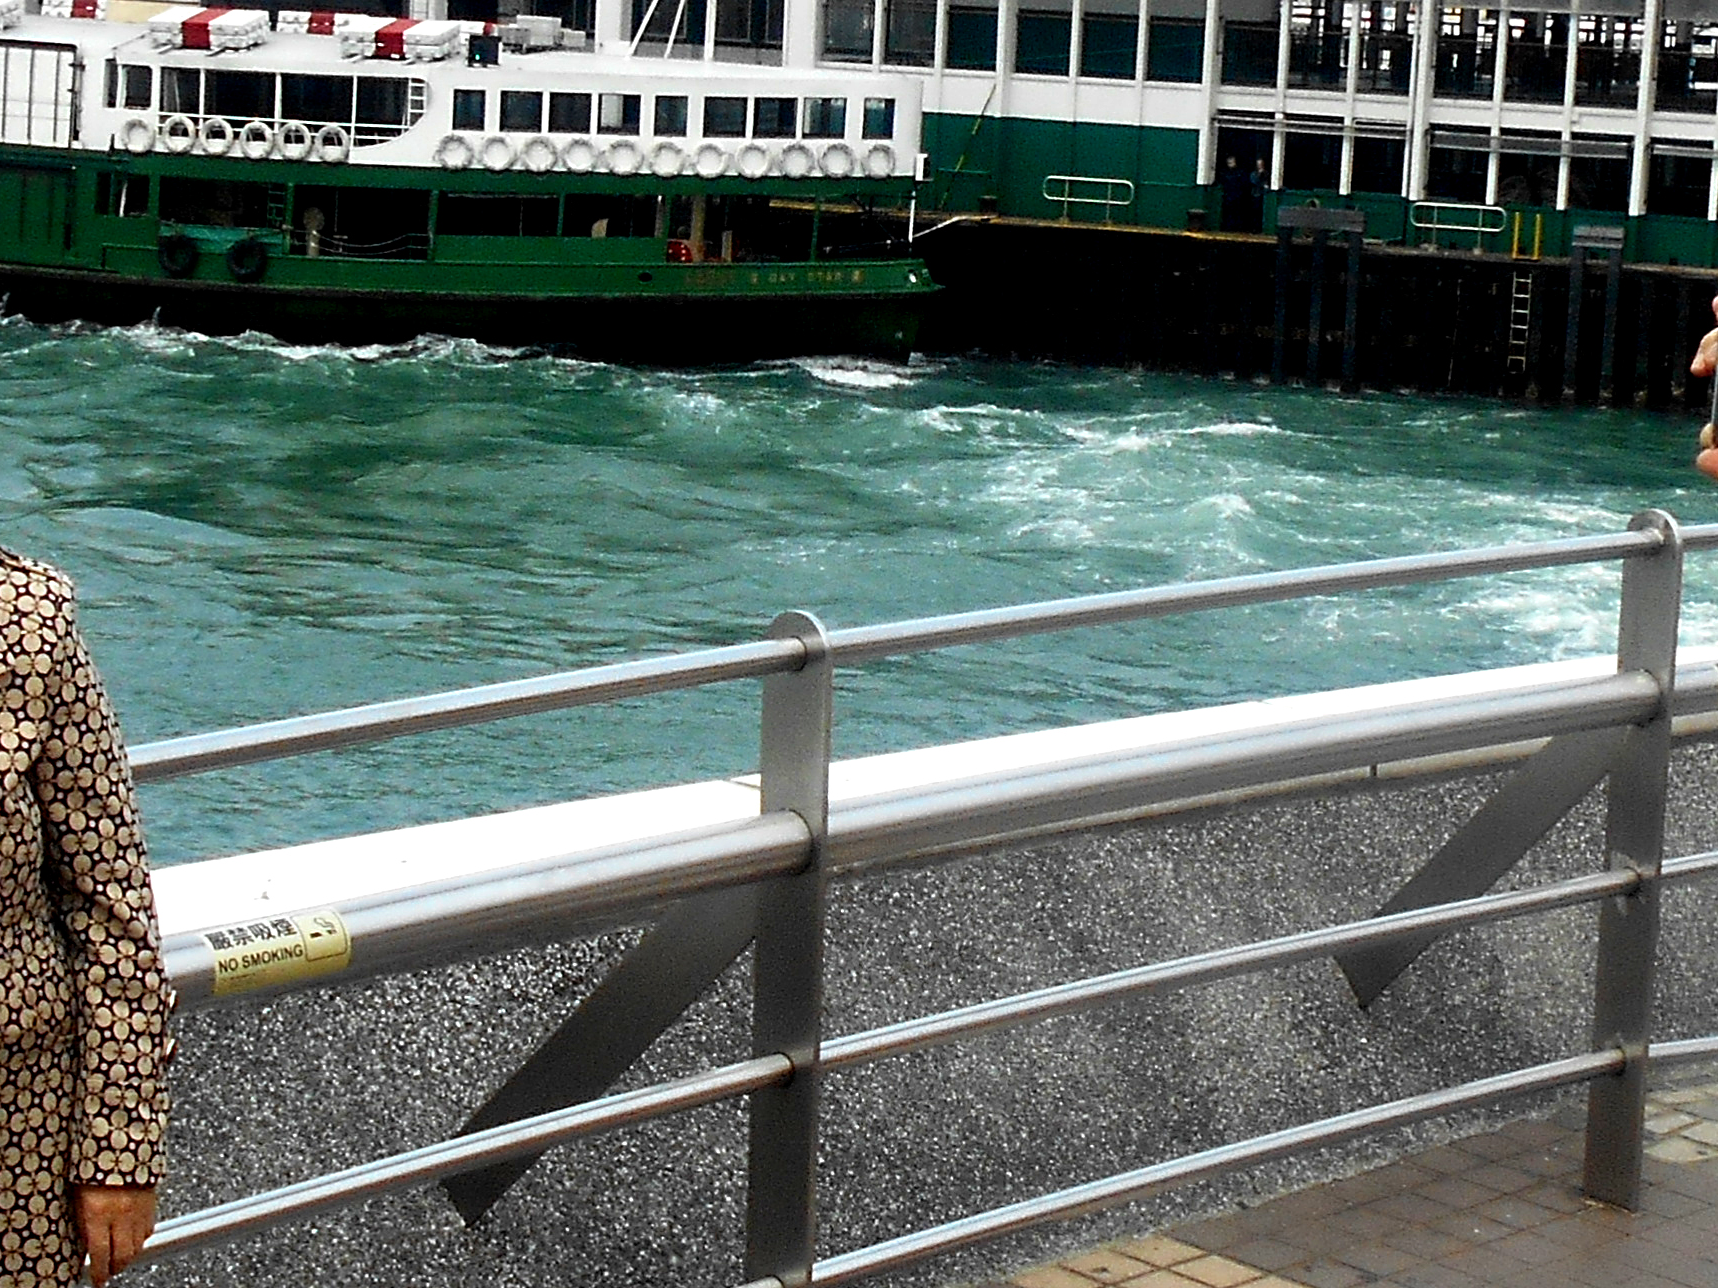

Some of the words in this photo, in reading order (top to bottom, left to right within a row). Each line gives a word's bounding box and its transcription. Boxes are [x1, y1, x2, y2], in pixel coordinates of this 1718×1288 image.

[205, 918, 298, 951] 嚴禁吸煙
[218, 957, 238, 974] NO
[242, 943, 303, 969] SMOKING
